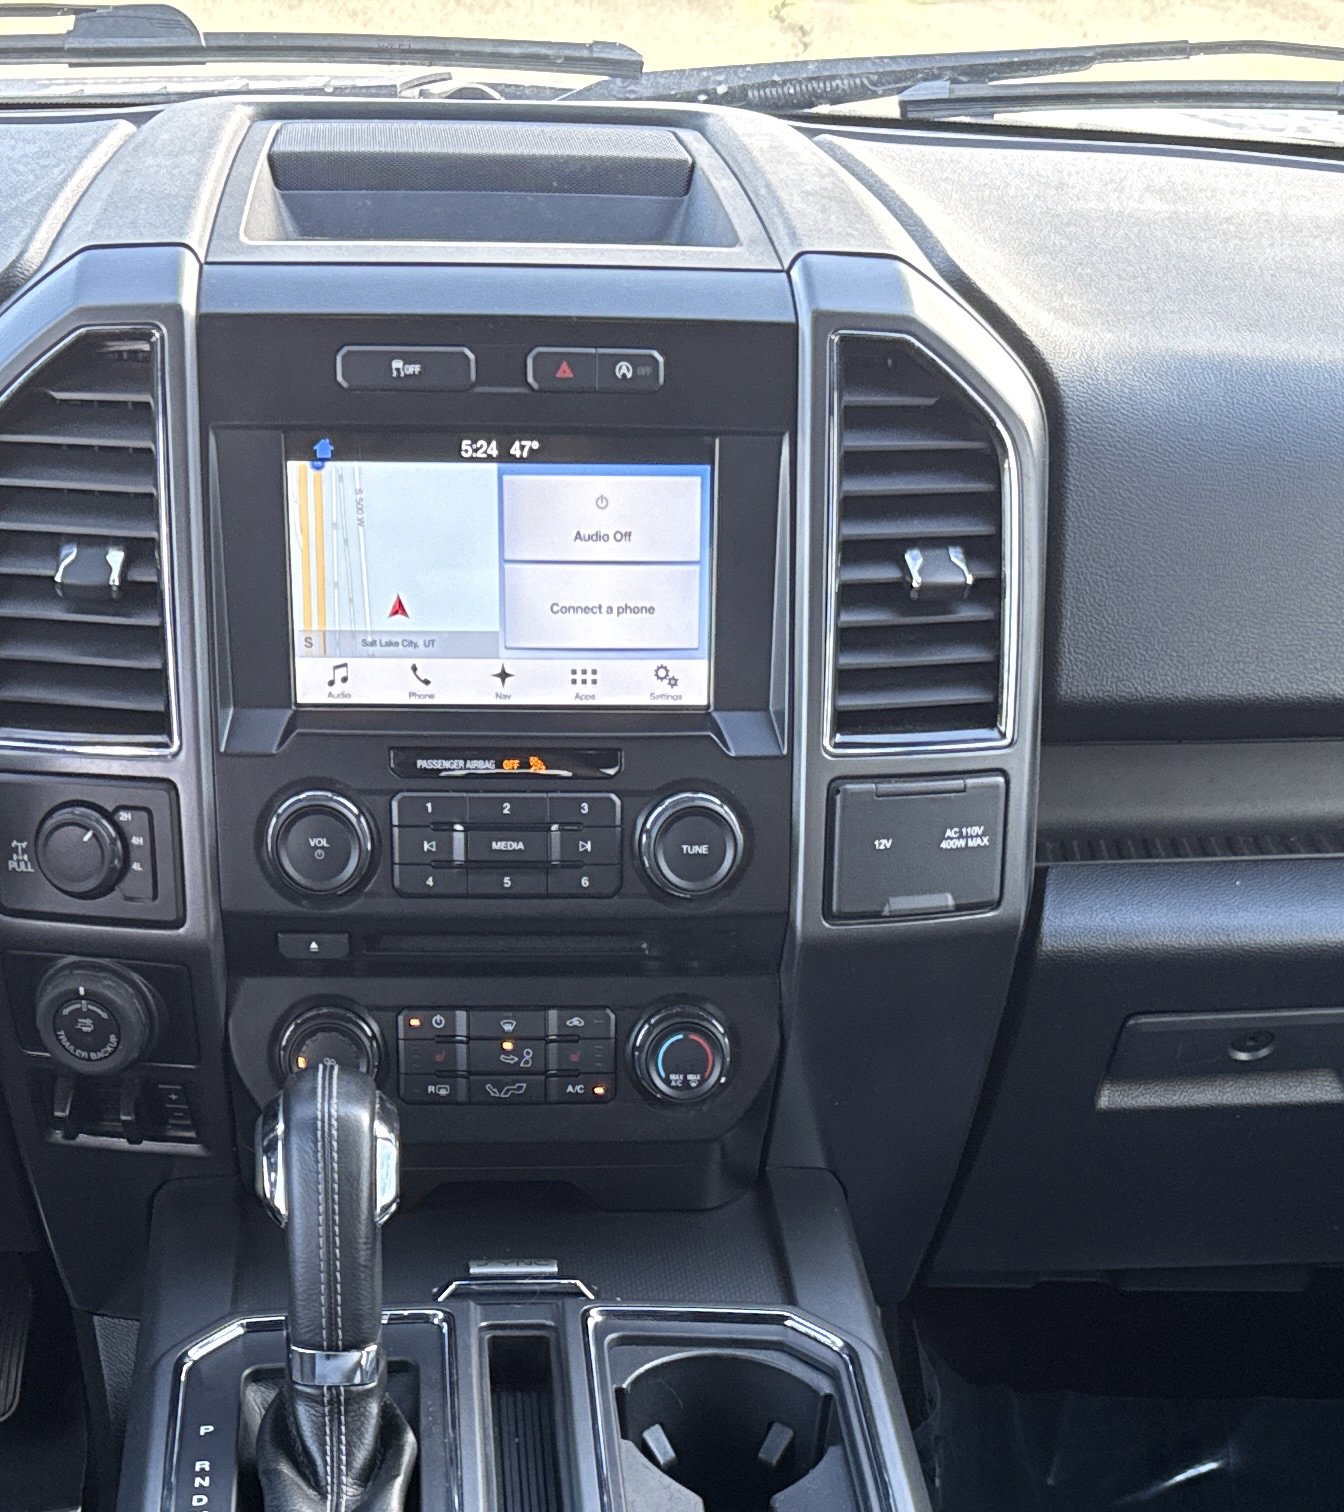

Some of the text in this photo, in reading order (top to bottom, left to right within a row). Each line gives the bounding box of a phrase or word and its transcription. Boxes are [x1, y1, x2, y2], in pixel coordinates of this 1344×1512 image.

[460, 439, 499, 459] 5:24
[574, 529, 633, 543] Audio Off
[550, 601, 656, 618] Connect a phone
[304, 636, 313, 649] S
[378, 638, 400, 649] Lake
[423, 638, 437, 649] UT
[327, 691, 352, 701] Audio
[408, 691, 436, 701] Phone
[494, 691, 512, 701] Nav
[574, 691, 597, 702] Apps
[649, 691, 683, 702] Settings
[416, 758, 521, 770] PASSENGER AIRBAG OFF
[425, 802, 433, 814] 1
[502, 802, 511, 814] 2
[580, 802, 589, 814] 3
[944, 825, 985, 838] AC 110V
[308, 837, 331, 848] VOL
[491, 840, 525, 851] MEDIA
[873, 838, 893, 850] 12V
[939, 836, 990, 850] 400W MAX
[681, 843, 709, 855] TUNE
[8, 859, 35, 872] PULL
[425, 876, 434, 888] 4
[503, 876, 512, 889] 5
[580, 876, 589, 888] 6
[56, 1030, 118, 1060] TRAILER BACKUP
[566, 1084, 585, 1095] A/C
[199, 1424, 215, 1436] P
[194, 1460, 211, 1473] R
[193, 1475, 210, 1488] N
[191, 1494, 209, 1507] D
